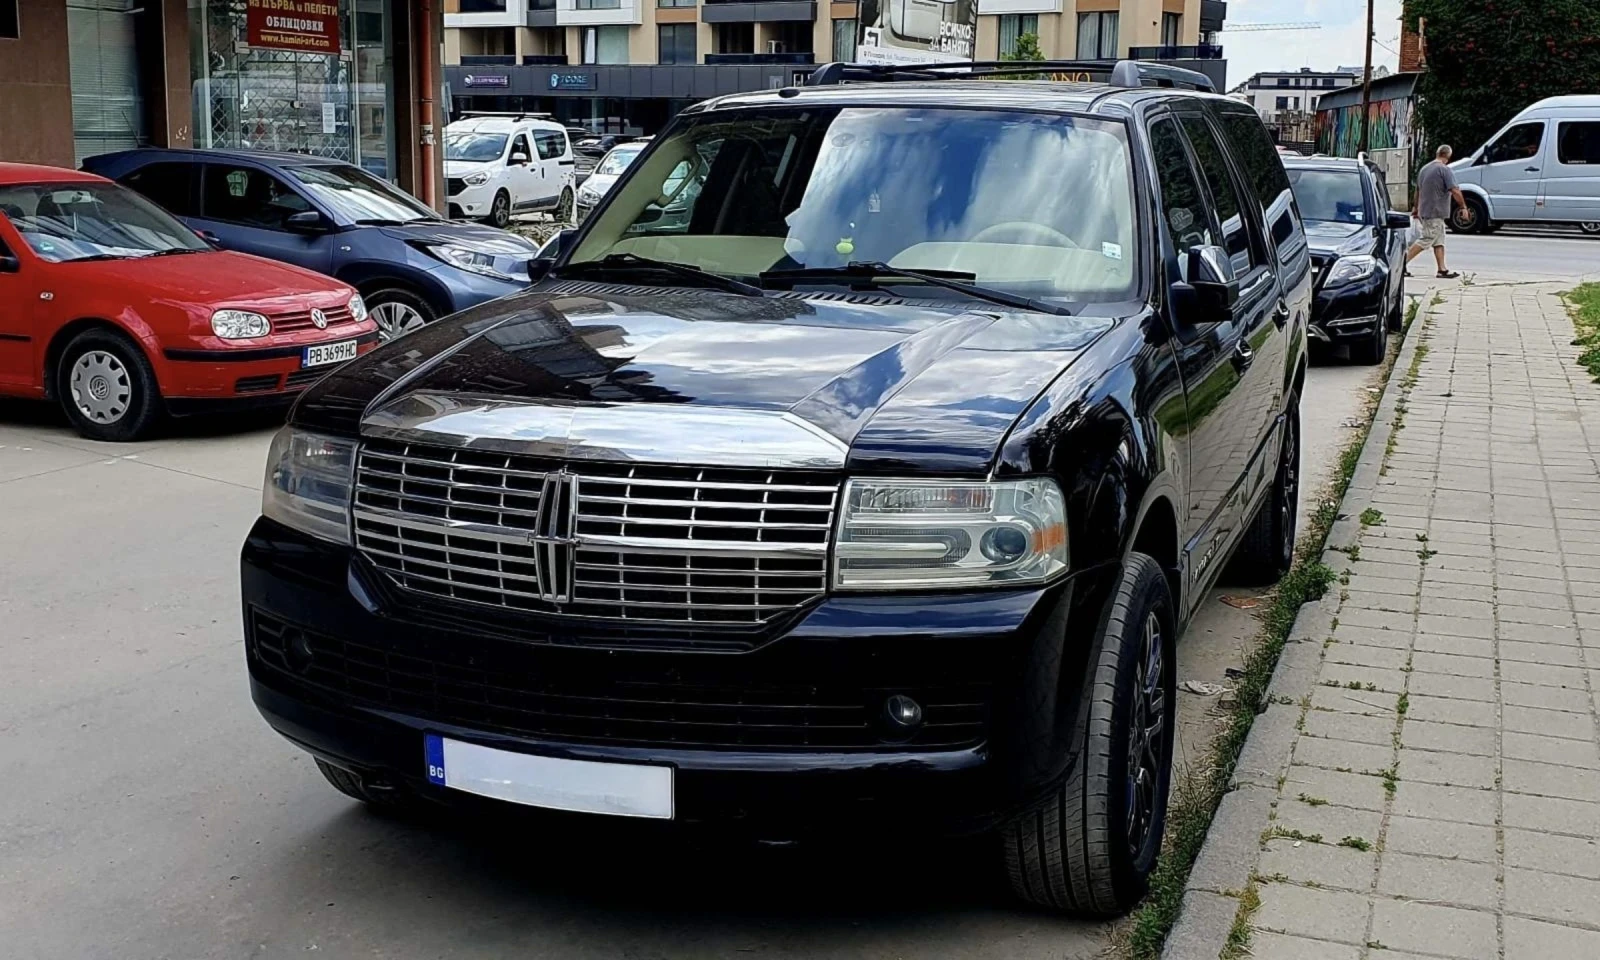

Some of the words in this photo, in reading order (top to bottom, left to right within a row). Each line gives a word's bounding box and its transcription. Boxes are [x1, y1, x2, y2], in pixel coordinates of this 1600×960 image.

[266, 15, 324, 32] ОБЛИЦОВКИ
[940, 21, 972, 39] ВСИЧКО
[260, 34, 330, 47] www.kamini-art.com
[929, 36, 940, 51] ЗА
[941, 38, 970, 56] БАНЯТА
[430, 765, 443, 778] BG
